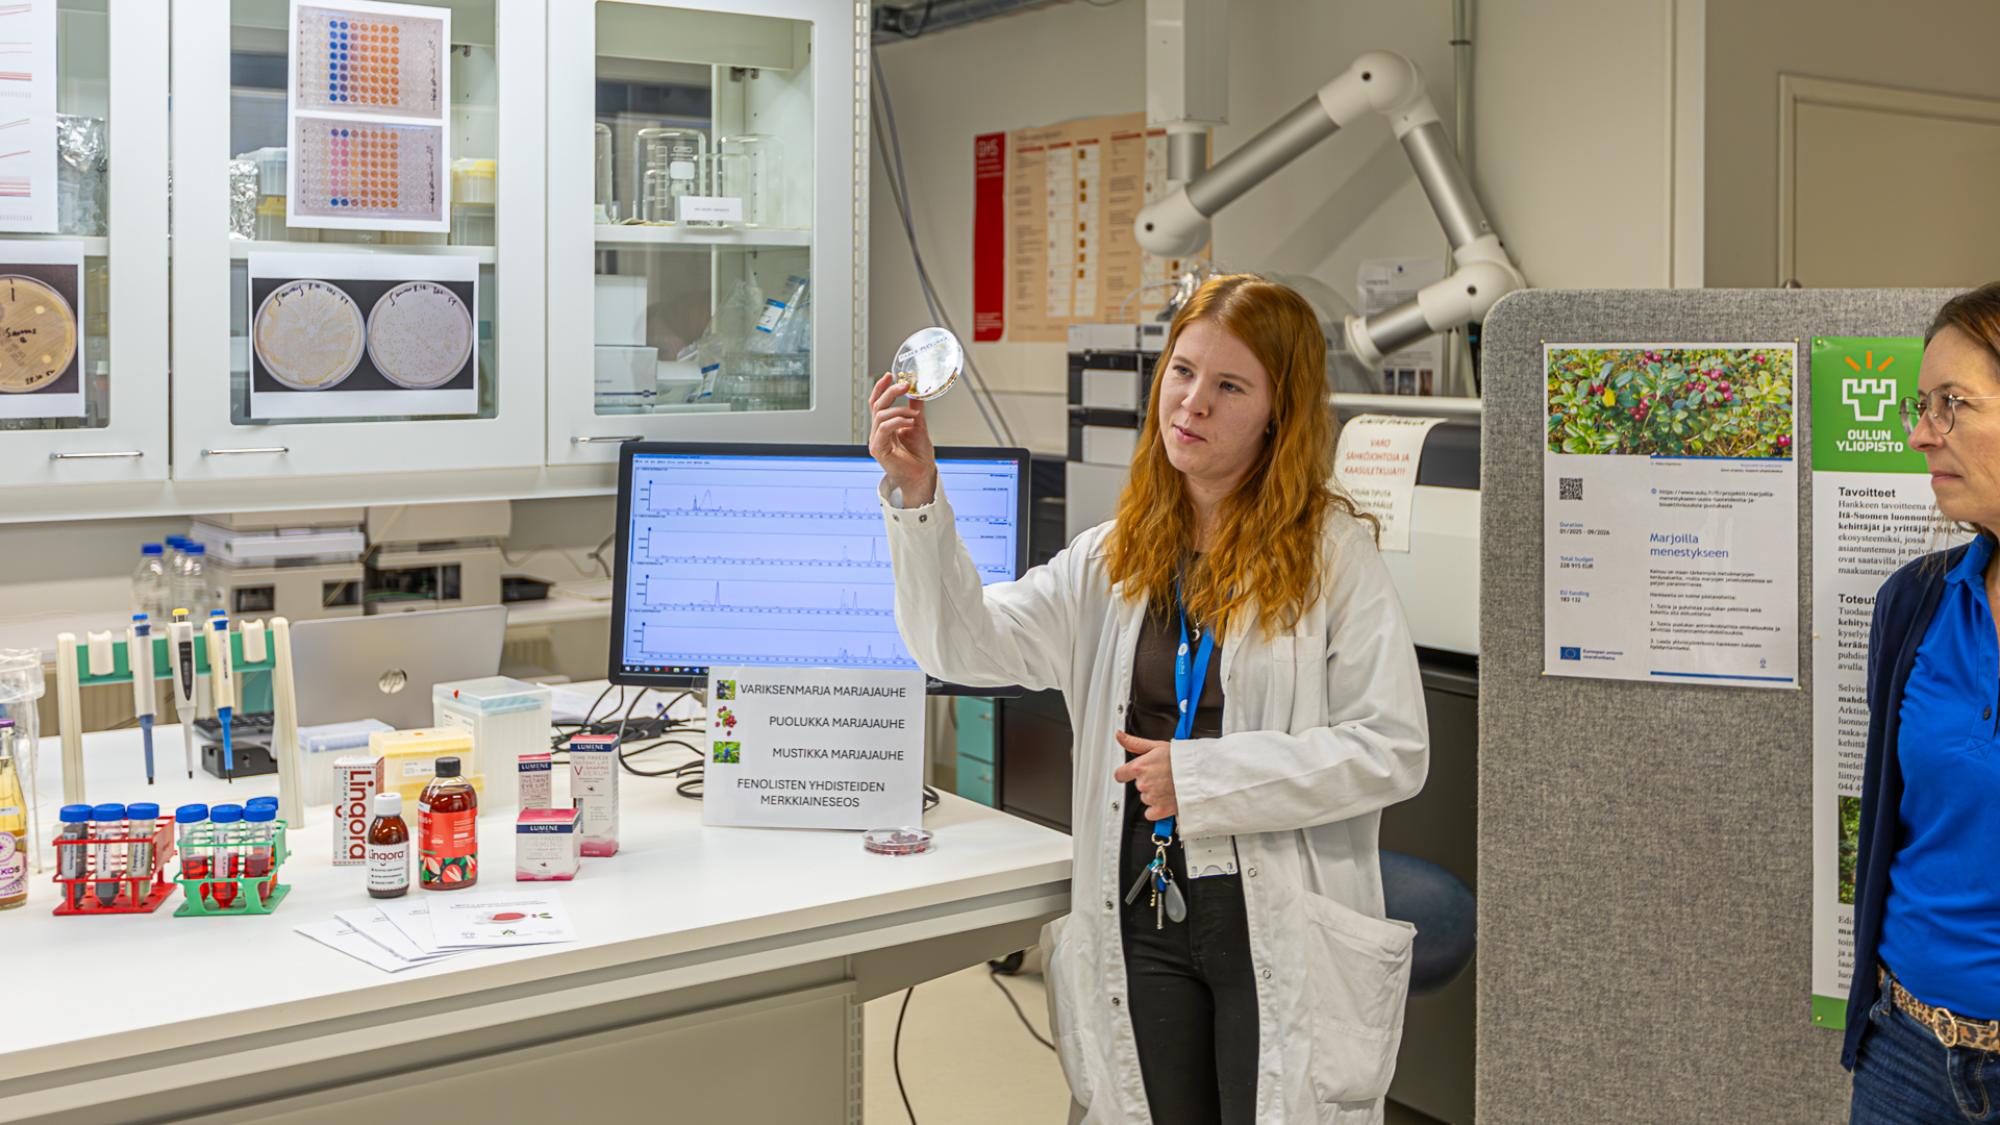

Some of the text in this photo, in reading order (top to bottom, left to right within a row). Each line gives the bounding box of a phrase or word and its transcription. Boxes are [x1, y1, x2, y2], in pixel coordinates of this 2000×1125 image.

[1847, 429, 1891, 441] OULUN
[1836, 440, 1904, 453] YLIOPISTO
[1838, 486, 1896, 498] Tavoitteet
[1838, 500, 1879, 509] Hankkeen
[1881, 502, 1927, 511] tavoitteena
[1838, 511, 1889, 521] Itä-Suomen
[1838, 522, 1880, 533] kehittäjät
[1882, 523, 1891, 533] ja
[1893, 523, 1930, 534] yrittäjät
[1650, 533, 1699, 545] Marjoilla
[1838, 533, 1926, 544] ekosysteemiksi, jossa
[1650, 547, 1729, 559] menestykseen
[1838, 544, 1897, 554] asiantuntemus
[1898, 547, 1906, 555] ja
[1838, 556, 1856, 564] ovat
[1858, 556, 1897, 565] saatavilla
[1838, 593, 1875, 605] Toteut
[740, 684, 907, 698] VARIKSENMARJA MARJAJAUHE
[769, 716, 905, 729] PUOLUKKA MARJAJAUHE
[773, 748, 904, 761] MUSTIKKA MARJAJAUHE
[737, 779, 885, 792] FENOLISTEN YHDISTEIDEN
[760, 796, 860, 807] MERKKIAINESEOS
[348, 770, 374, 860] Lingora
[369, 849, 404, 860] Lingora
